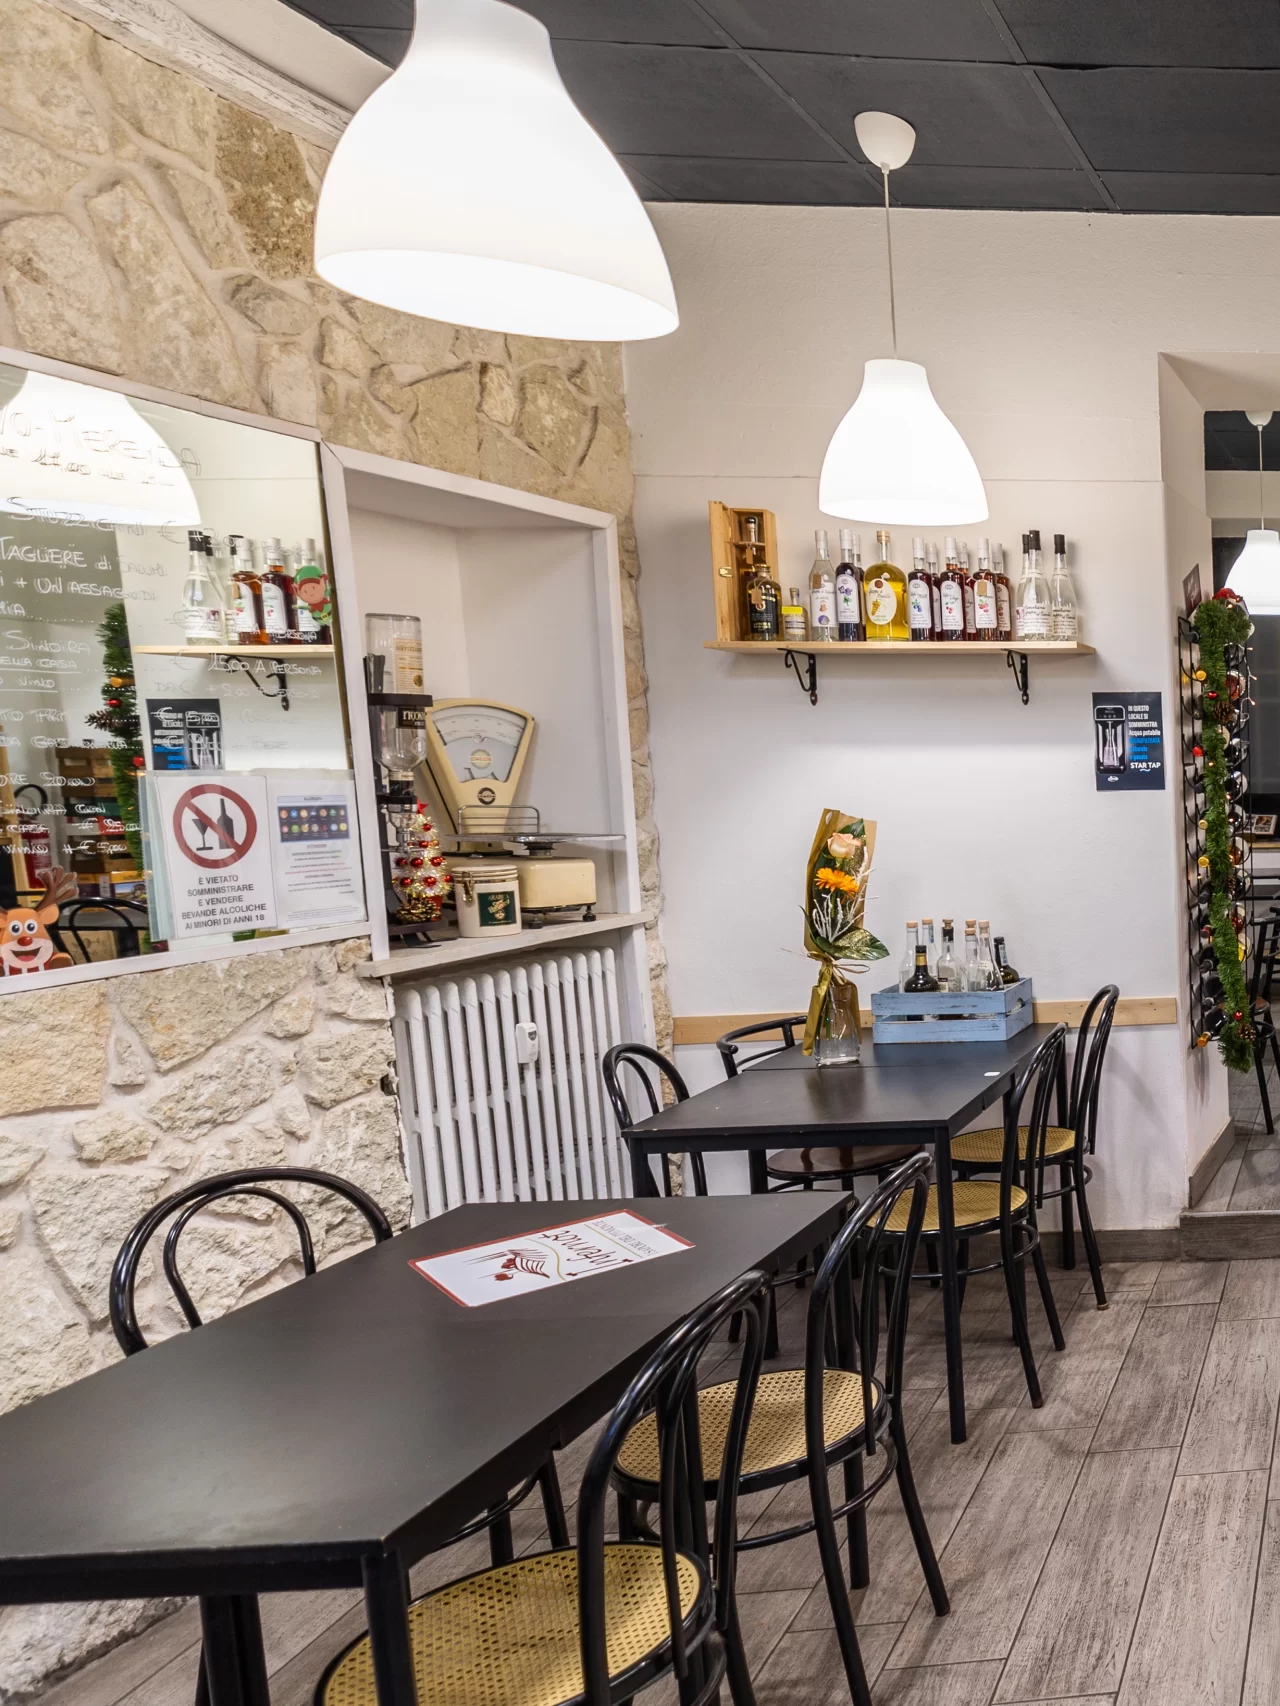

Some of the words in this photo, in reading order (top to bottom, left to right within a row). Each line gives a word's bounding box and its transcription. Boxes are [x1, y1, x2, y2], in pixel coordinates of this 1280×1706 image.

[1128, 729, 1142, 737] Acqua
[205, 874, 239, 885] VIETATO
[187, 883, 254, 897] SOMMINISTRARE
[197, 898, 203, 907] E
[204, 894, 244, 906] VENDERE
[181, 908, 217, 920] BEVANDE
[218, 903, 267, 916] ALCOLICHE
[185, 922, 193, 931] AI
[193, 918, 221, 930] MINORI
[223, 916, 231, 925] DI
[232, 914, 253, 924] ANNI
[255, 913, 265, 921] 18
[537, 1230, 634, 1277] Infernot
